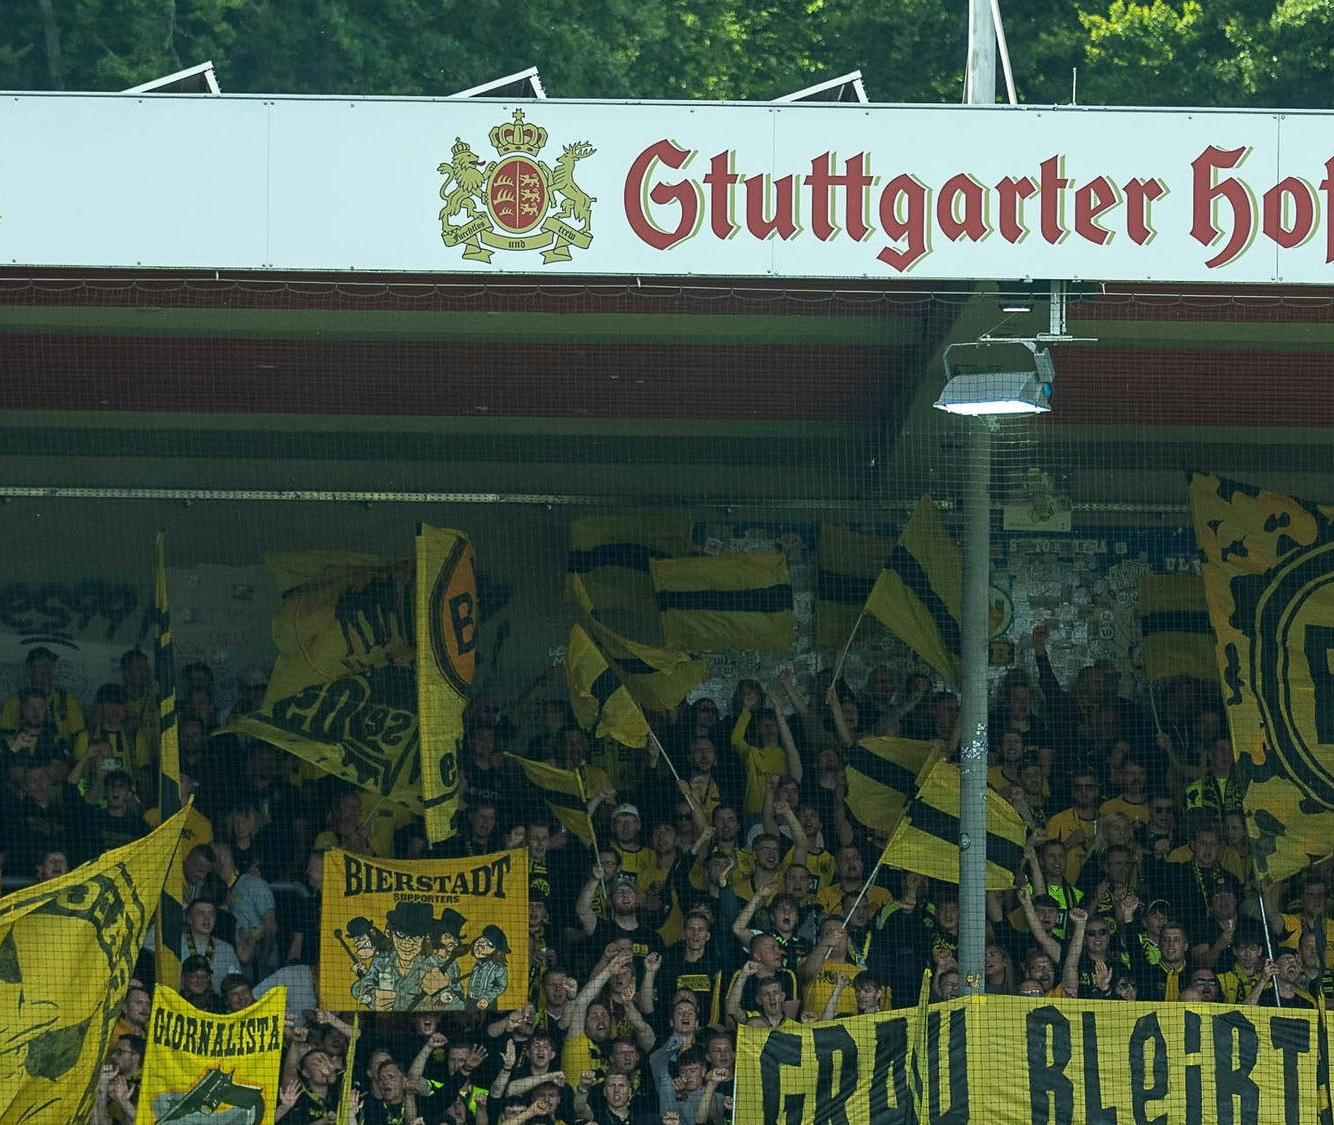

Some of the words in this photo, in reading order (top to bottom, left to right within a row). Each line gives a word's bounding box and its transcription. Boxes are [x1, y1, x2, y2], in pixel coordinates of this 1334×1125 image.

[624, 137, 1167, 272] Stuttgarter
[343, 854, 511, 898] BIERSTADT
[392, 892, 459, 904] SUPPORTERS
[153, 1006, 281, 1057] GIORNALISTA
